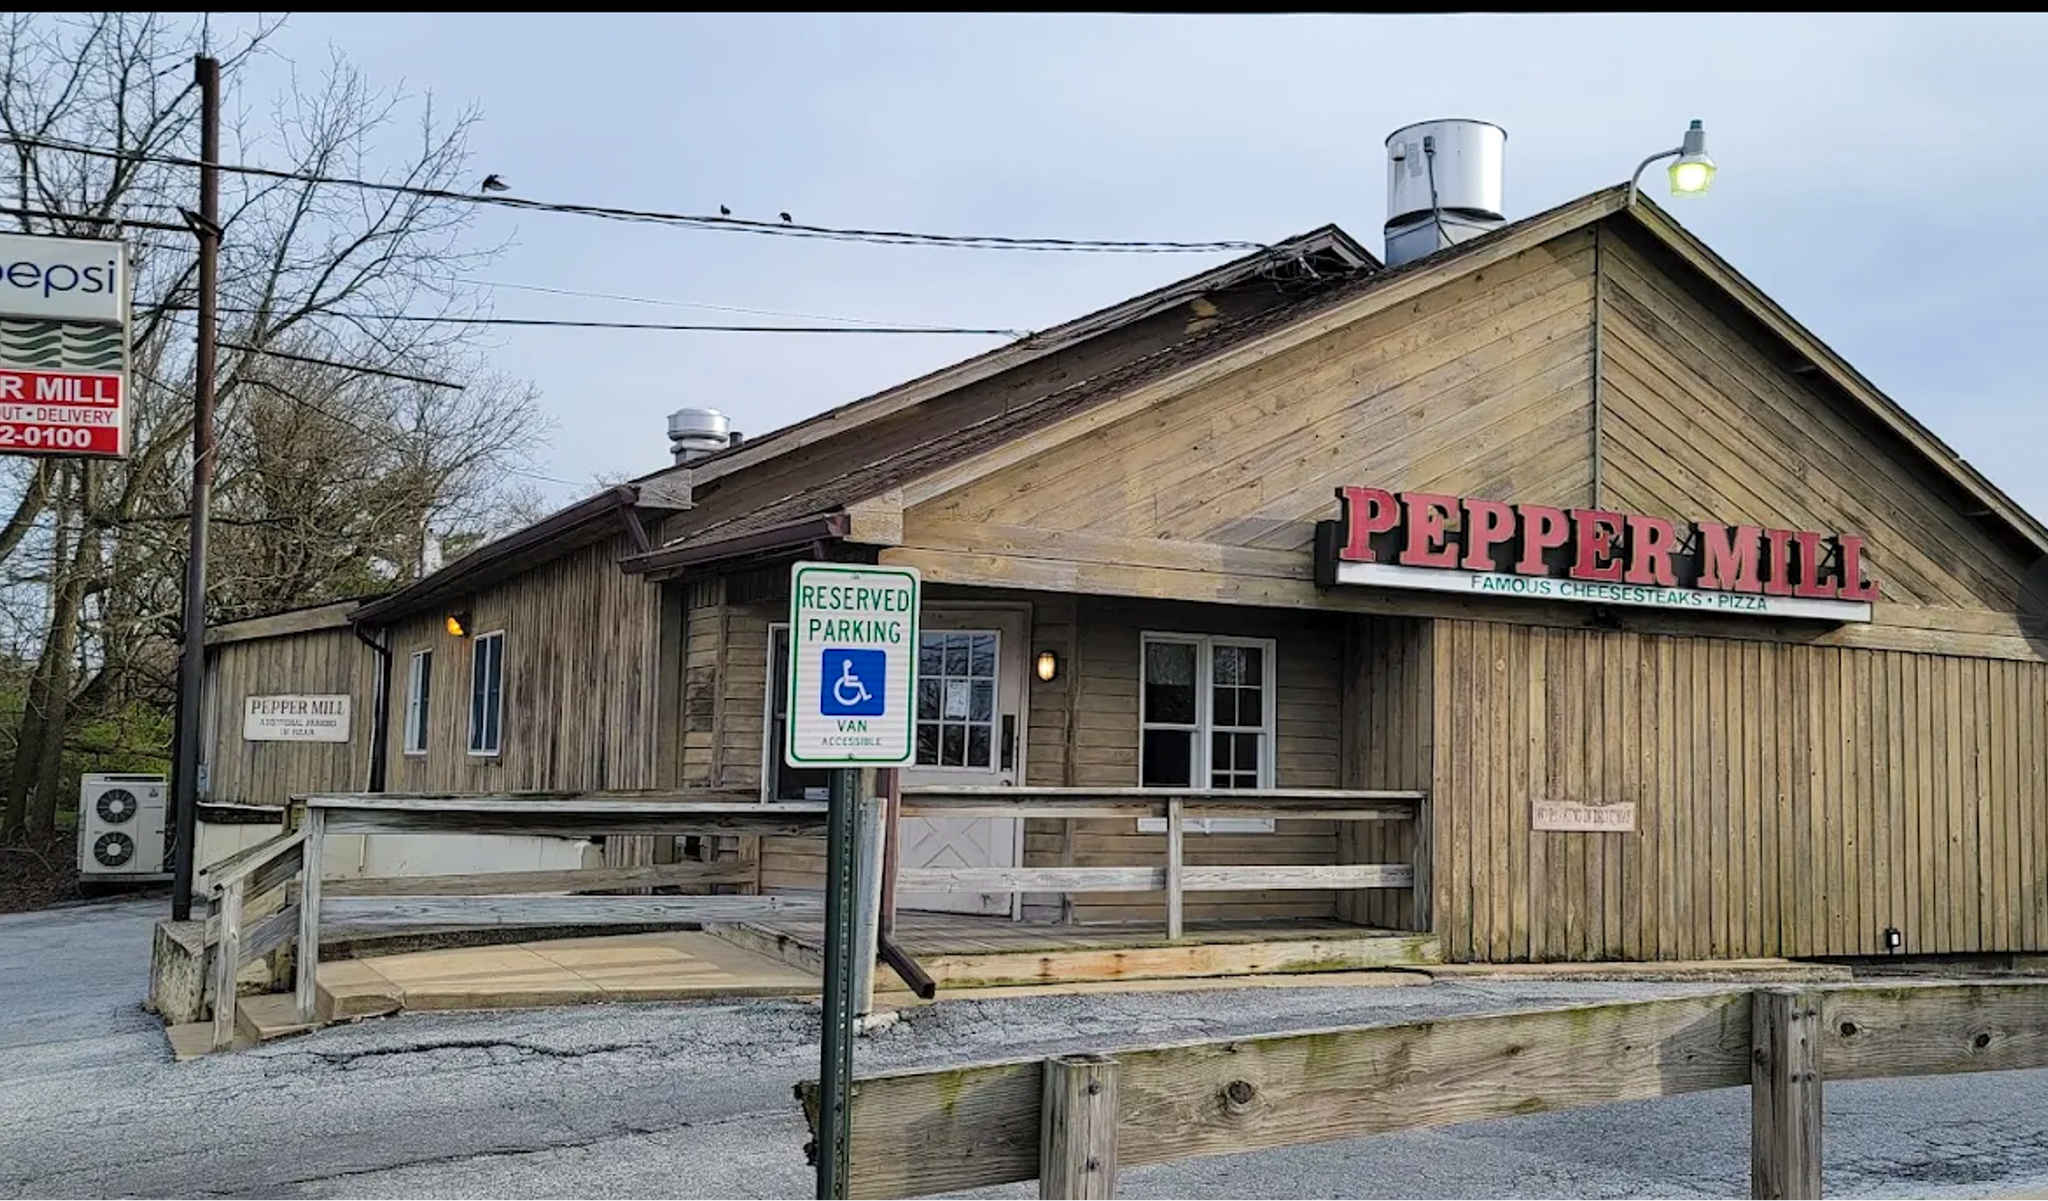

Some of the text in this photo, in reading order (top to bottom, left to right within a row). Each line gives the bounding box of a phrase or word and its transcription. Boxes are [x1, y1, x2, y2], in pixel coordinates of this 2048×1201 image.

[0, 260, 115, 298] epsi
[35, 377, 115, 403] MILL
[36, 407, 113, 424] DELIVERY
[1339, 486, 1882, 601] PEPPER MILL
[802, 585, 910, 612] RESERVED
[1470, 573, 1769, 612] FAMOUS CHEESESTEAKS PIZZA
[809, 618, 901, 644] PARKING
[251, 700, 345, 716] PEPPER MILL
[837, 720, 868, 732] VAN
[821, 736, 882, 747] ACCESSIBLE
